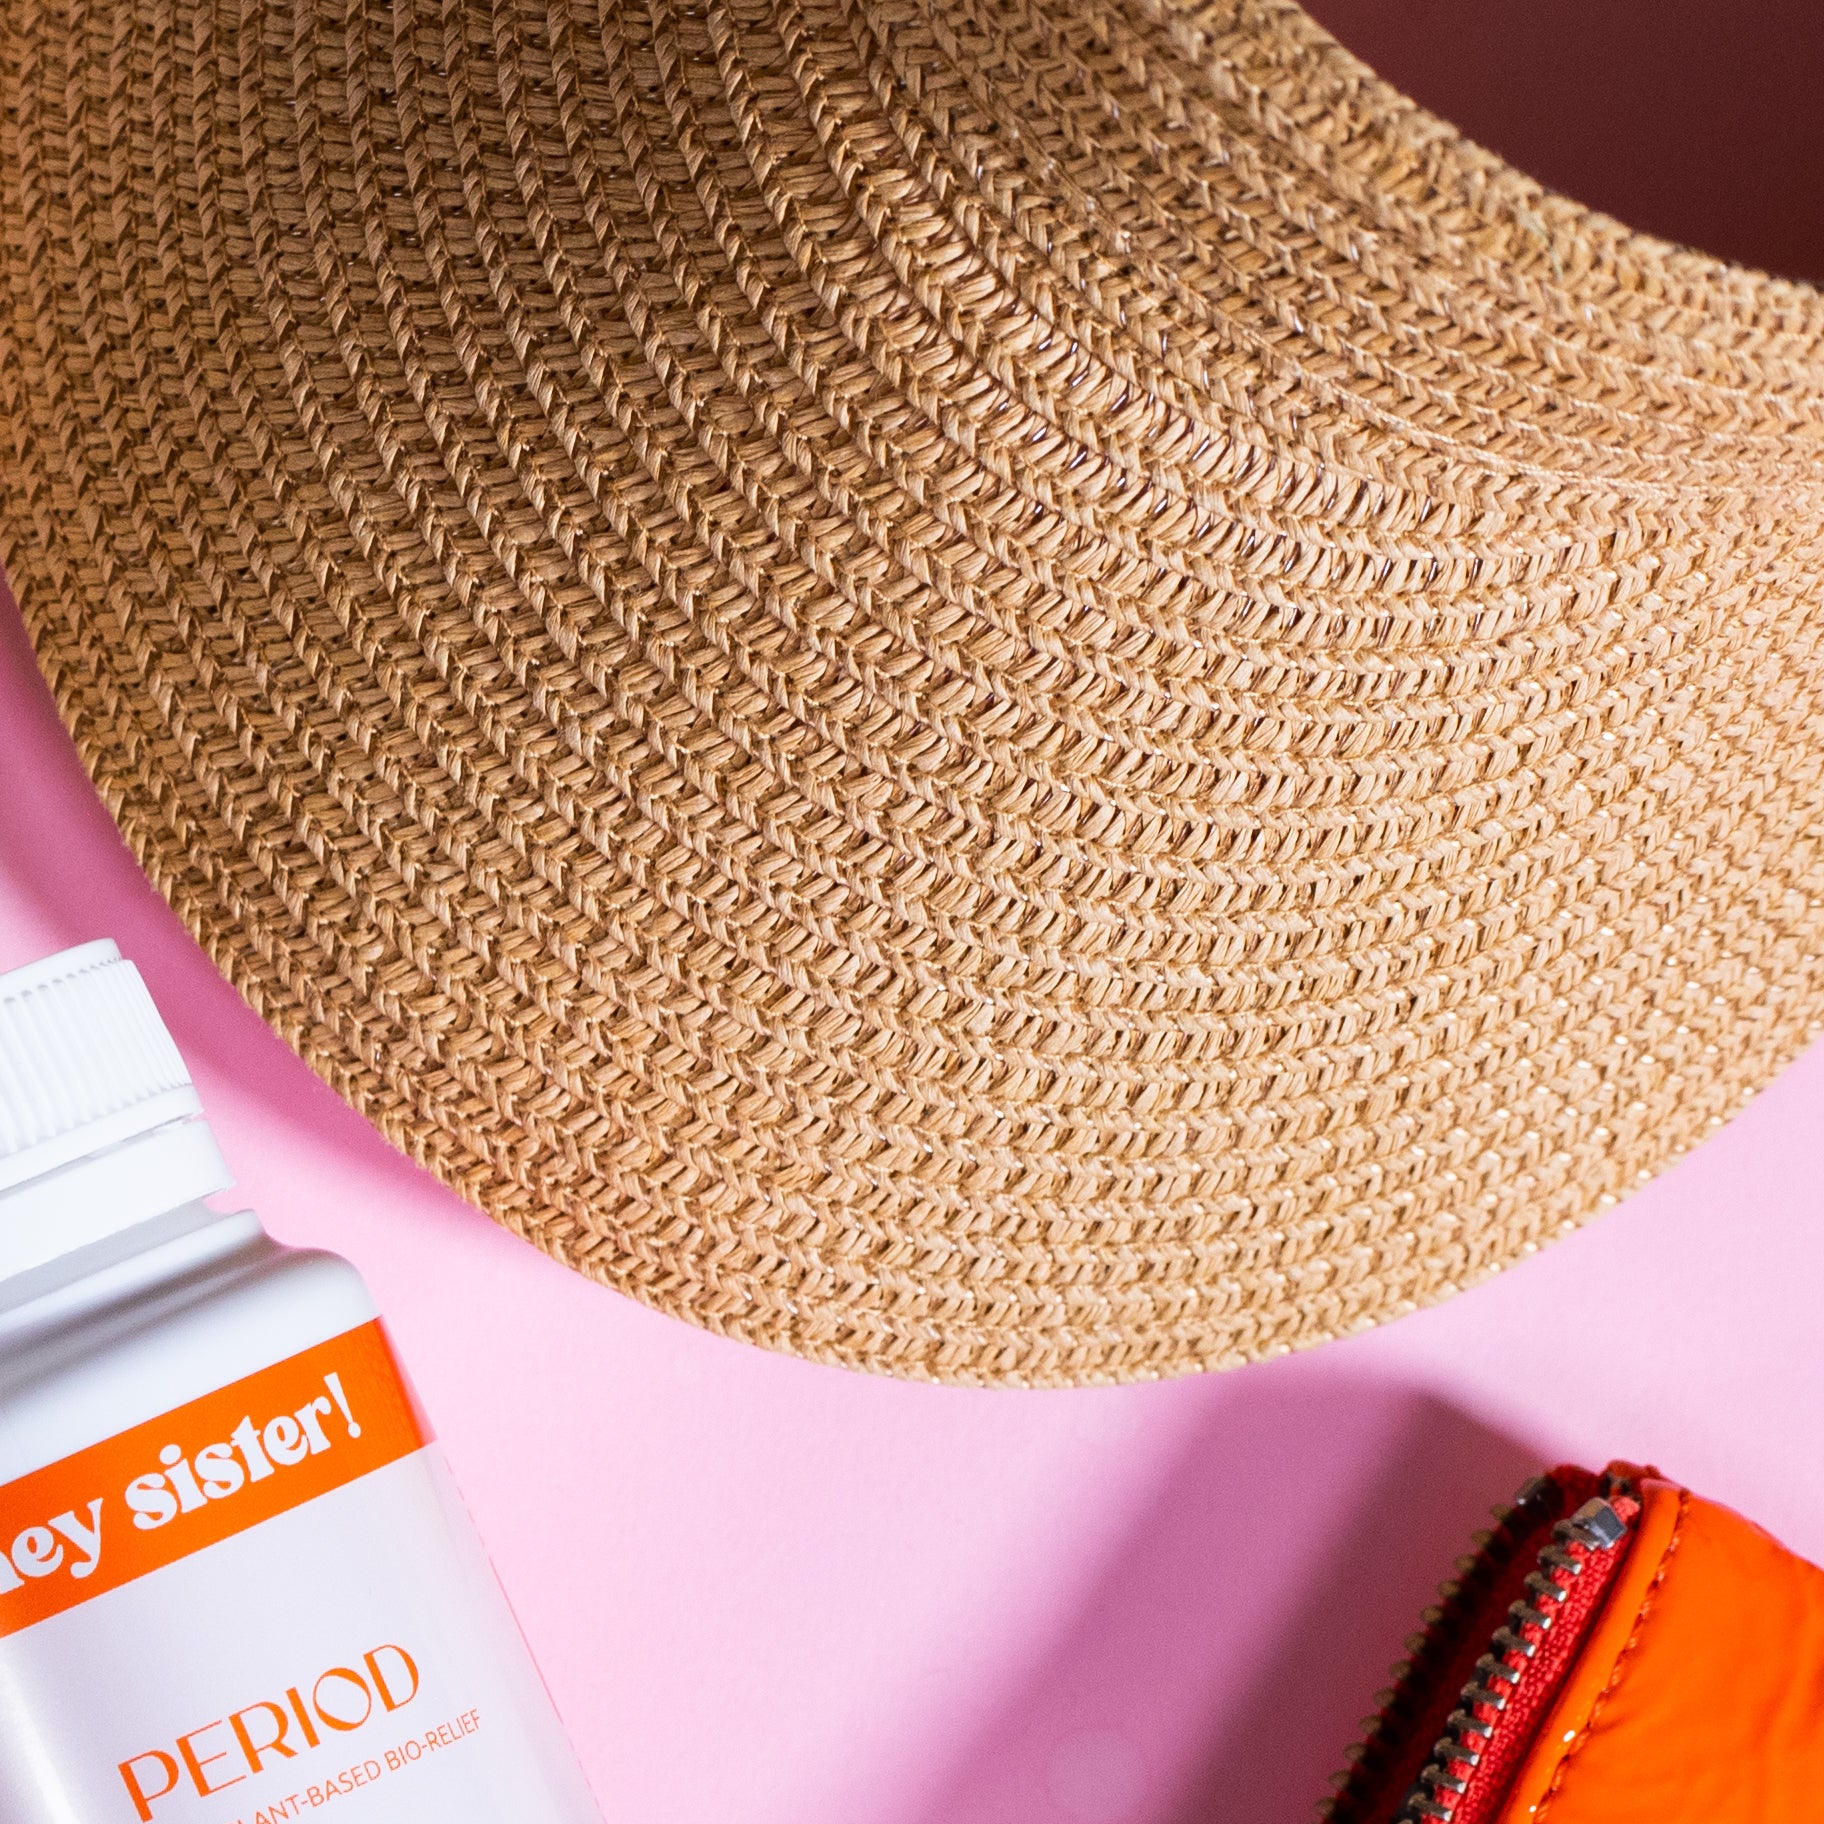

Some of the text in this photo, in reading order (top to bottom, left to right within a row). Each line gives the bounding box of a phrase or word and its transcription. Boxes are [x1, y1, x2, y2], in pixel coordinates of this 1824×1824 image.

[126, 1374, 359, 1528] sister!
[118, 1645, 419, 1823] PERIOD
[384, 1709, 479, 1771] BIO-RELIEF
